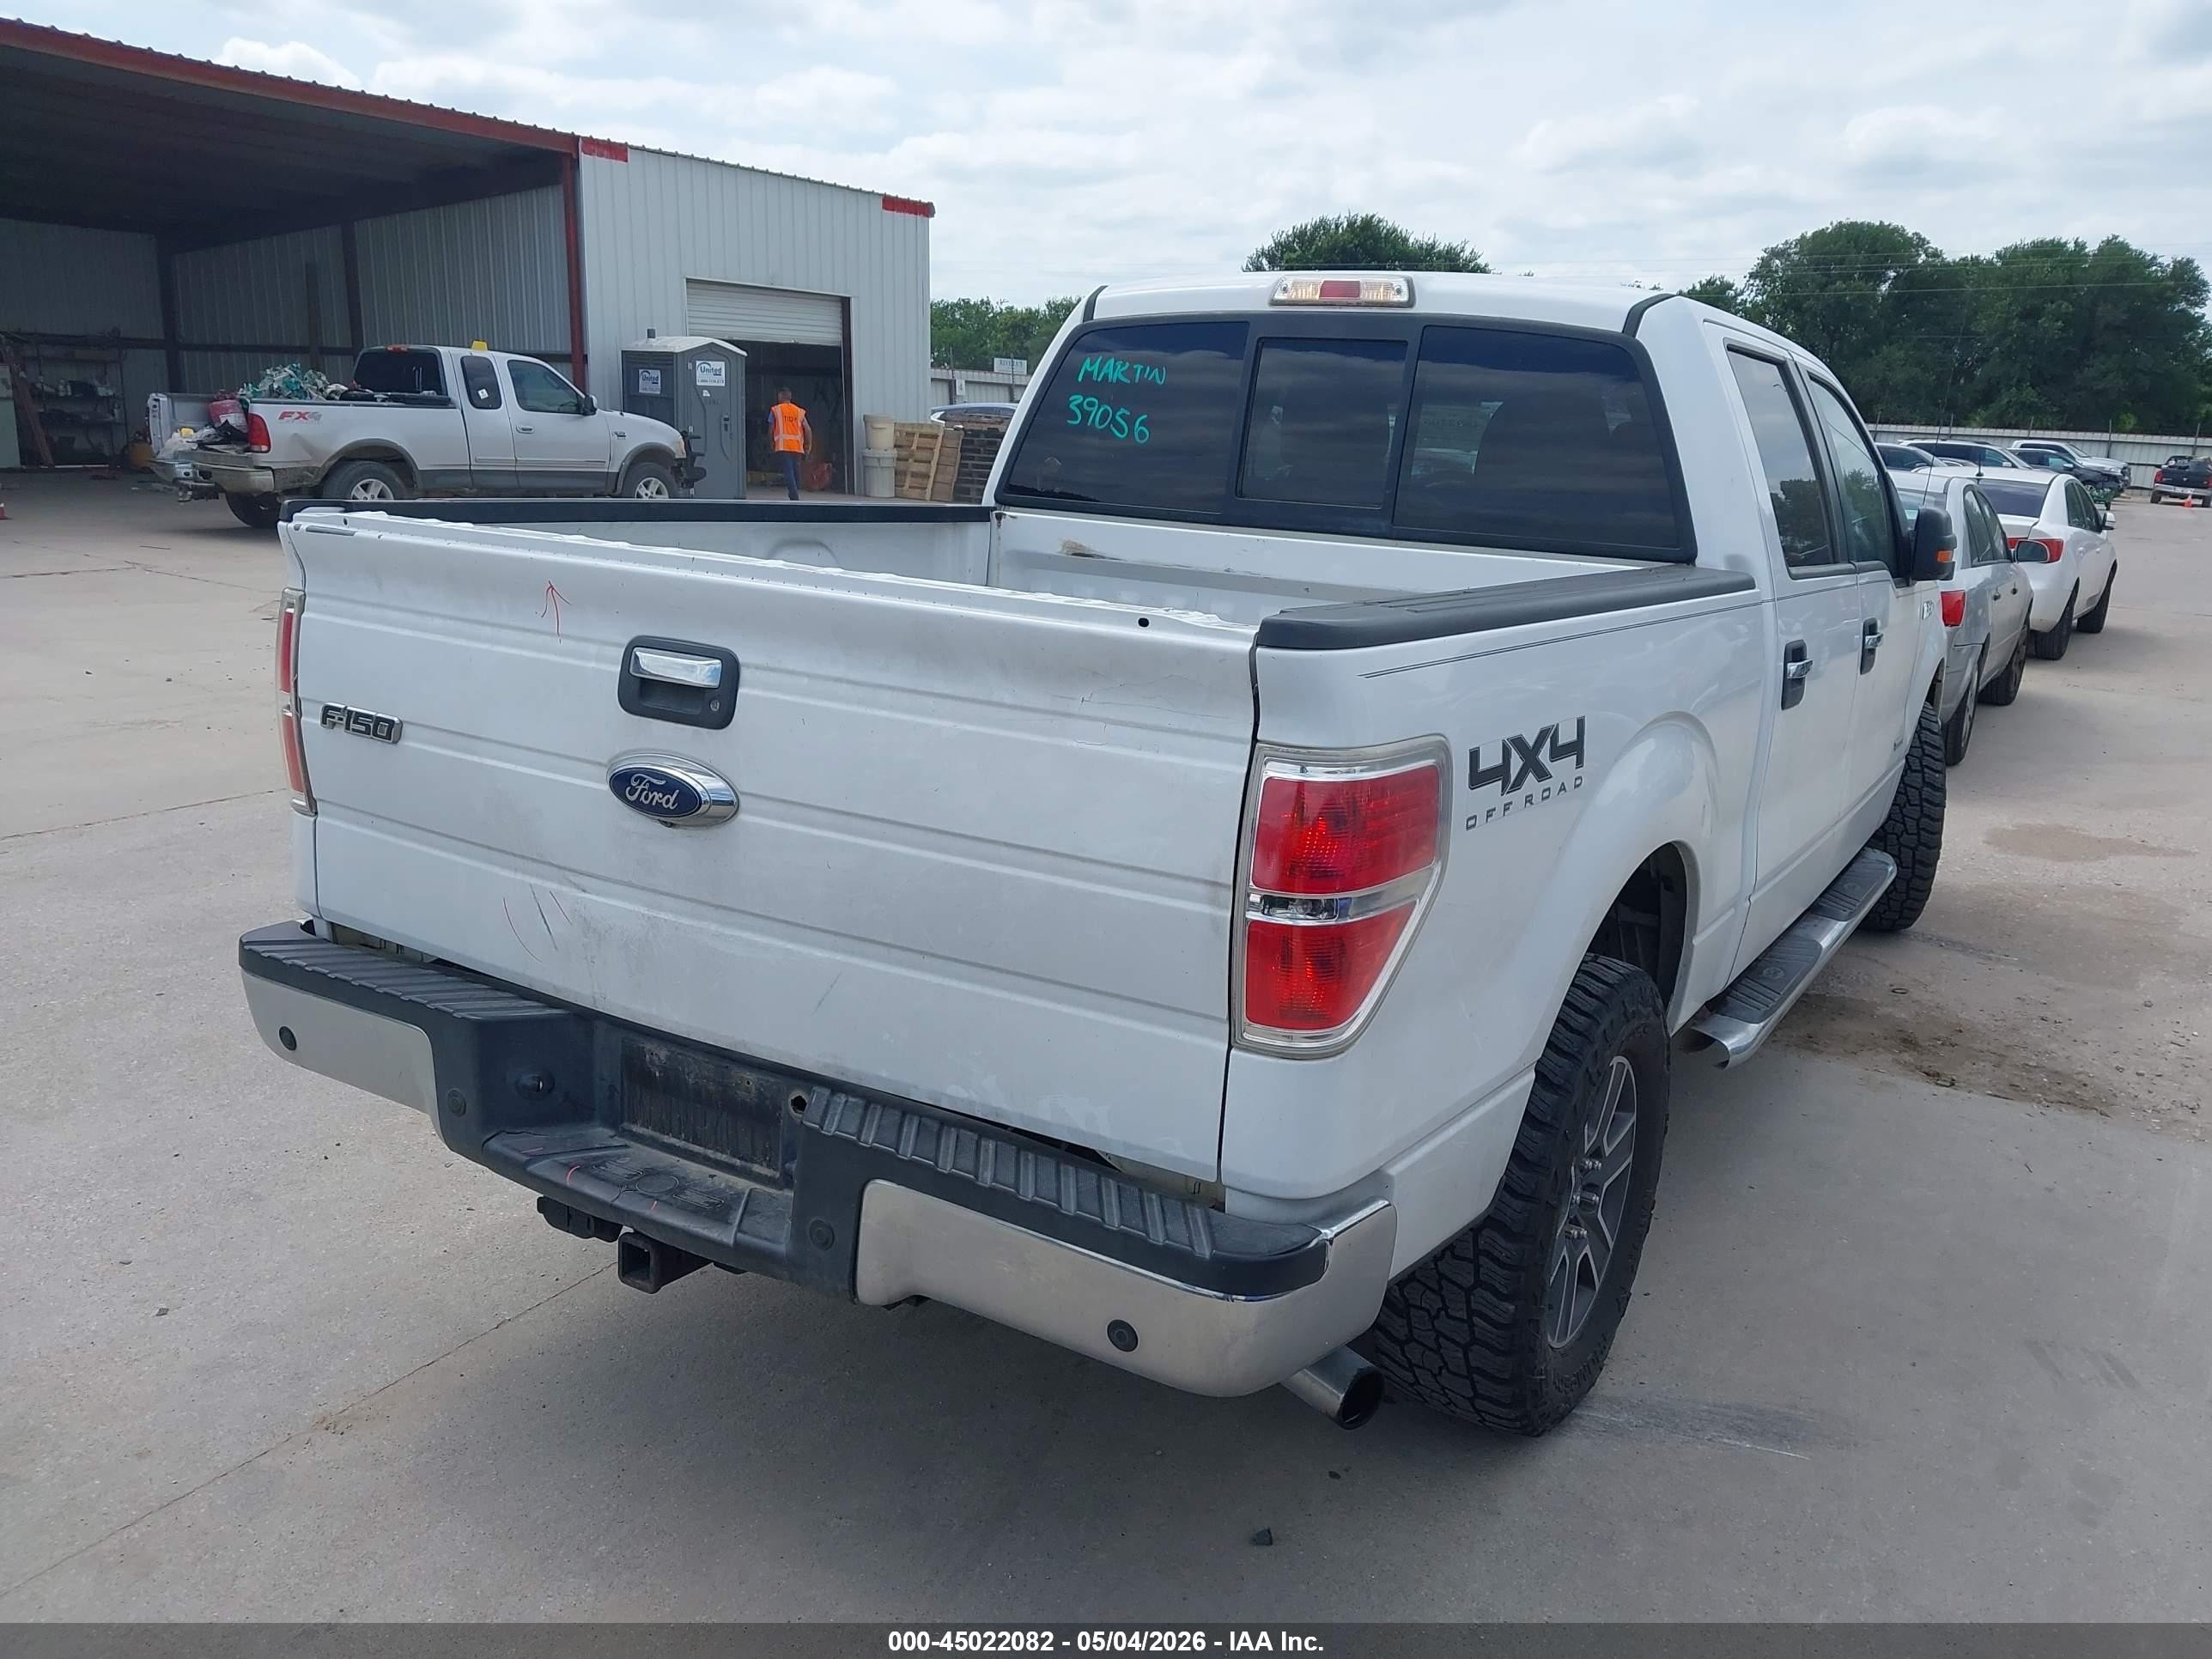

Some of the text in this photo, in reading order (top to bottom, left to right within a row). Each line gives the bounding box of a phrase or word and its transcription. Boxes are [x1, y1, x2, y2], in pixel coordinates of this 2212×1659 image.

[1078, 356, 1166, 385] MARTIN
[278, 410, 322, 421] FX4
[1066, 394, 1150, 444] 39056
[320, 702, 403, 744] F-150
[625, 773, 680, 810] Ford
[1466, 775, 1583, 831] OFF ROAD
